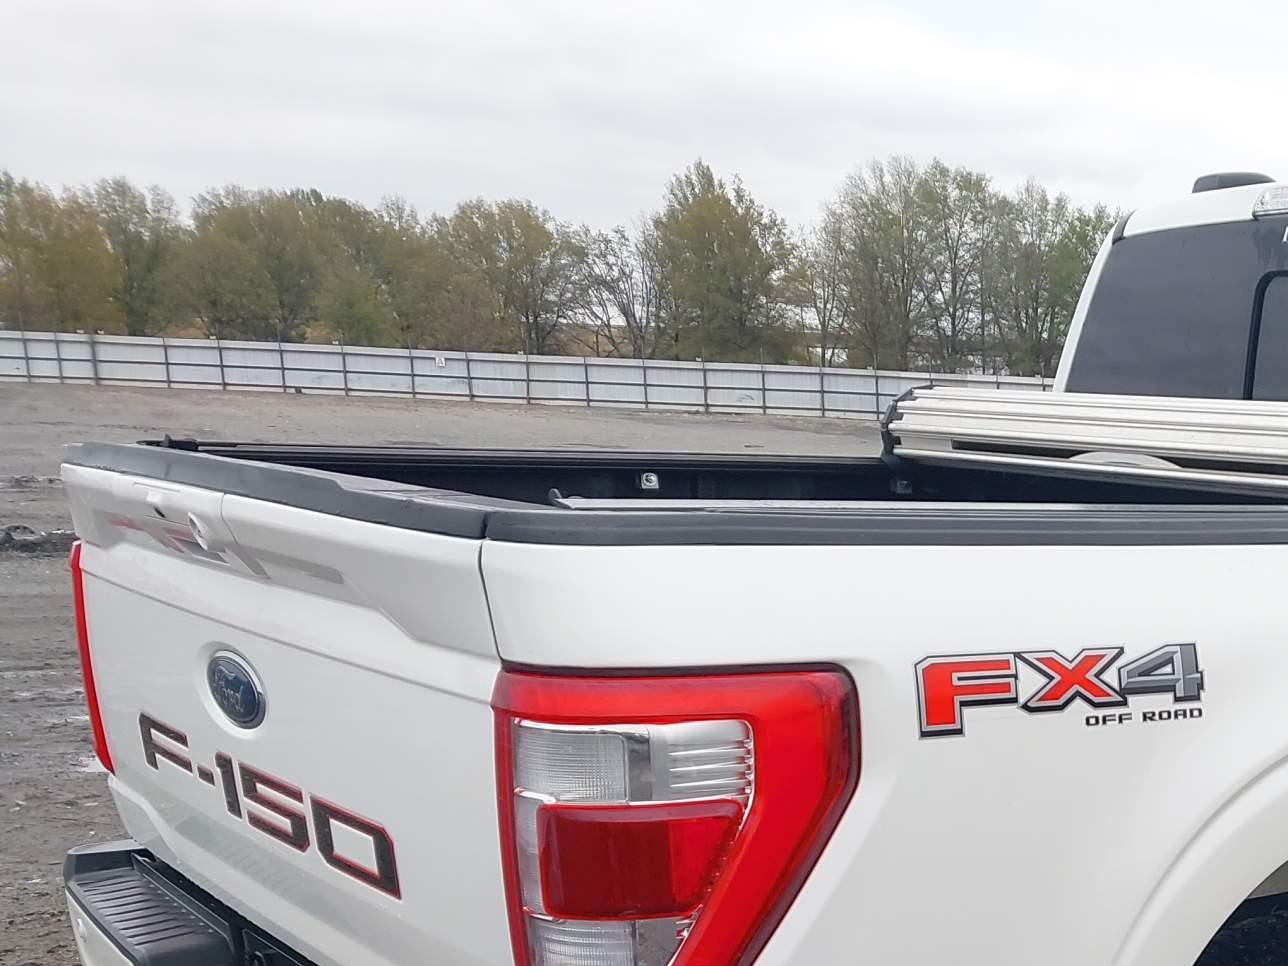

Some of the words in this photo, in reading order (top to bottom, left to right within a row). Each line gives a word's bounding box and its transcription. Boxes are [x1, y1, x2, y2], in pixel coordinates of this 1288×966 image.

[912, 641, 1206, 740] FX4
[1085, 713, 1132, 727] OFF
[1142, 707, 1203, 722] ROAD
[138, 711, 403, 900] F-150
